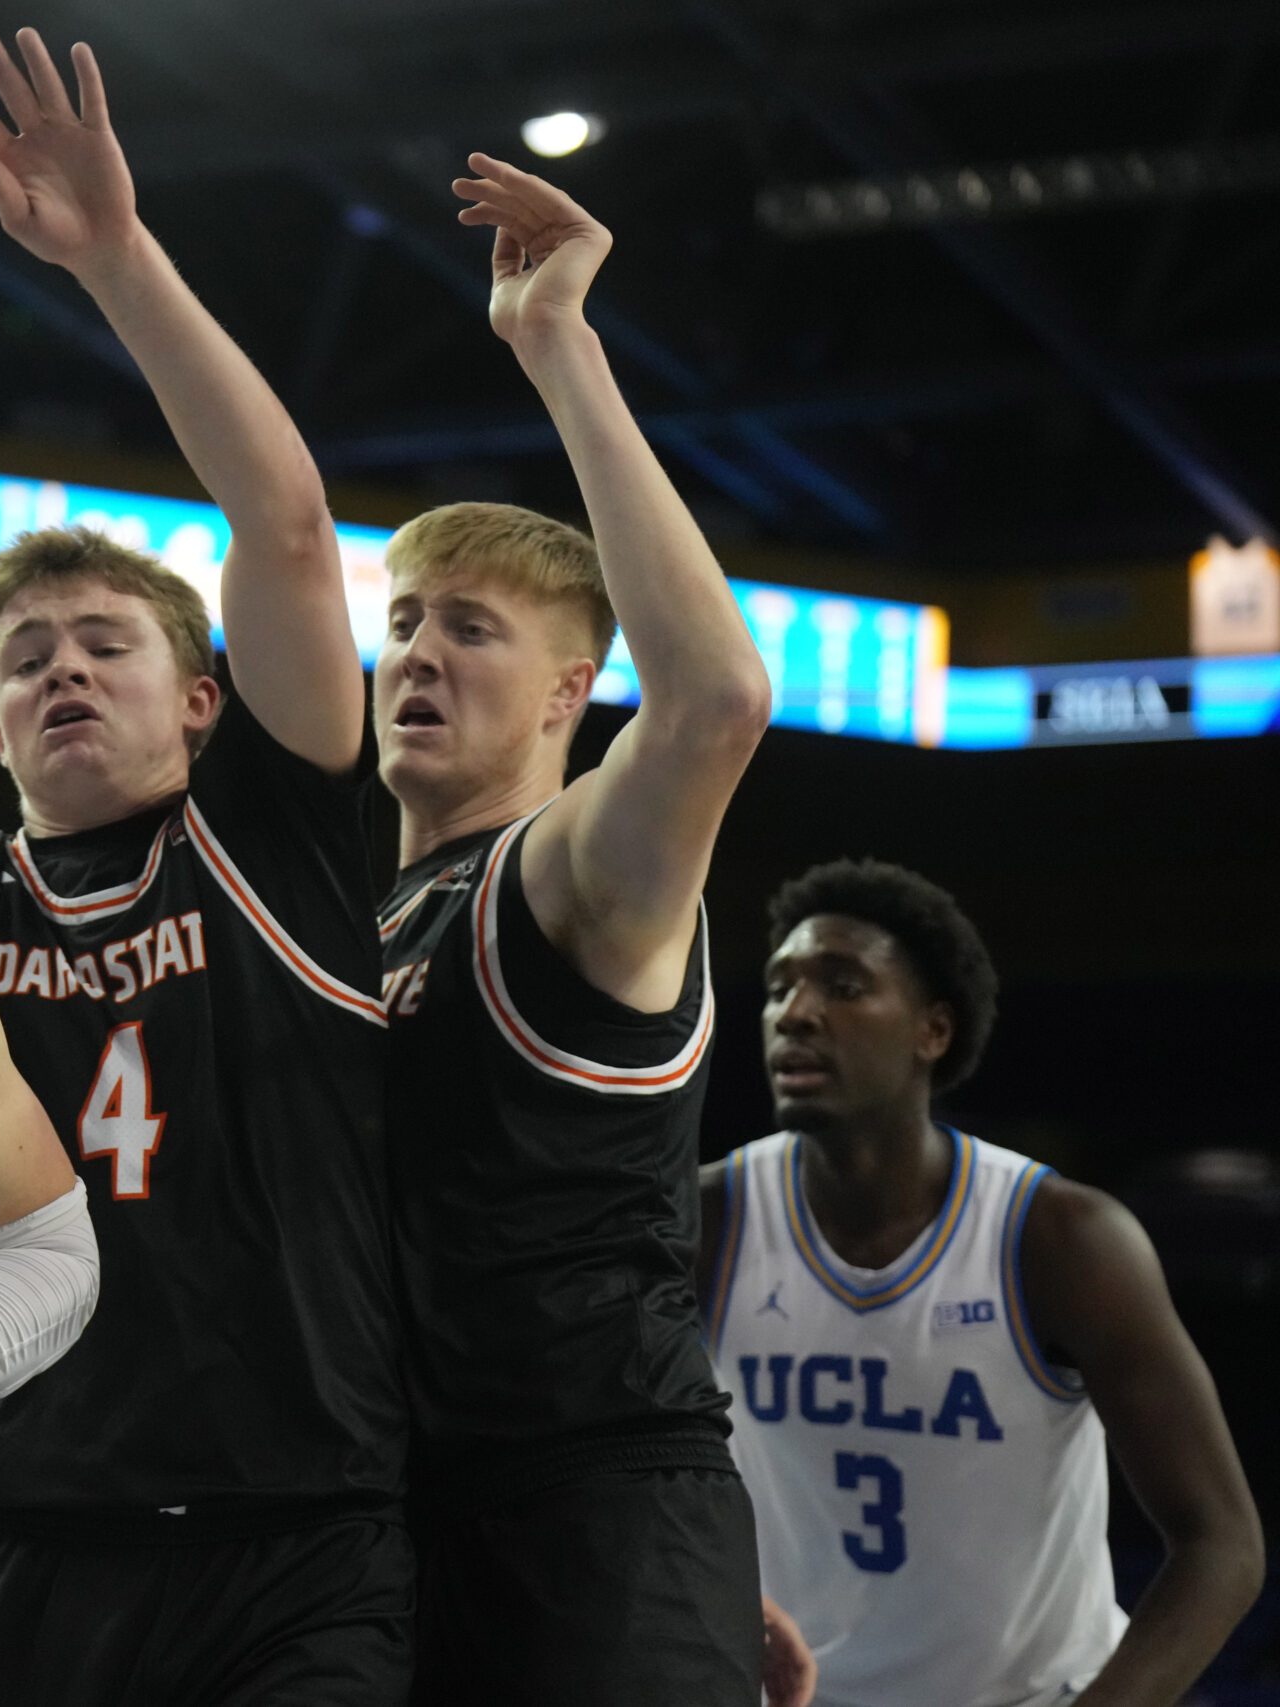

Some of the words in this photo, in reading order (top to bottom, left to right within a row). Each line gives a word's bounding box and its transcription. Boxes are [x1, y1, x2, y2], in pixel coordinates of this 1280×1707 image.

[77, 1020, 168, 1201] 4
[739, 1355, 1004, 1441] UCLA
[835, 1451, 907, 1574] 3
